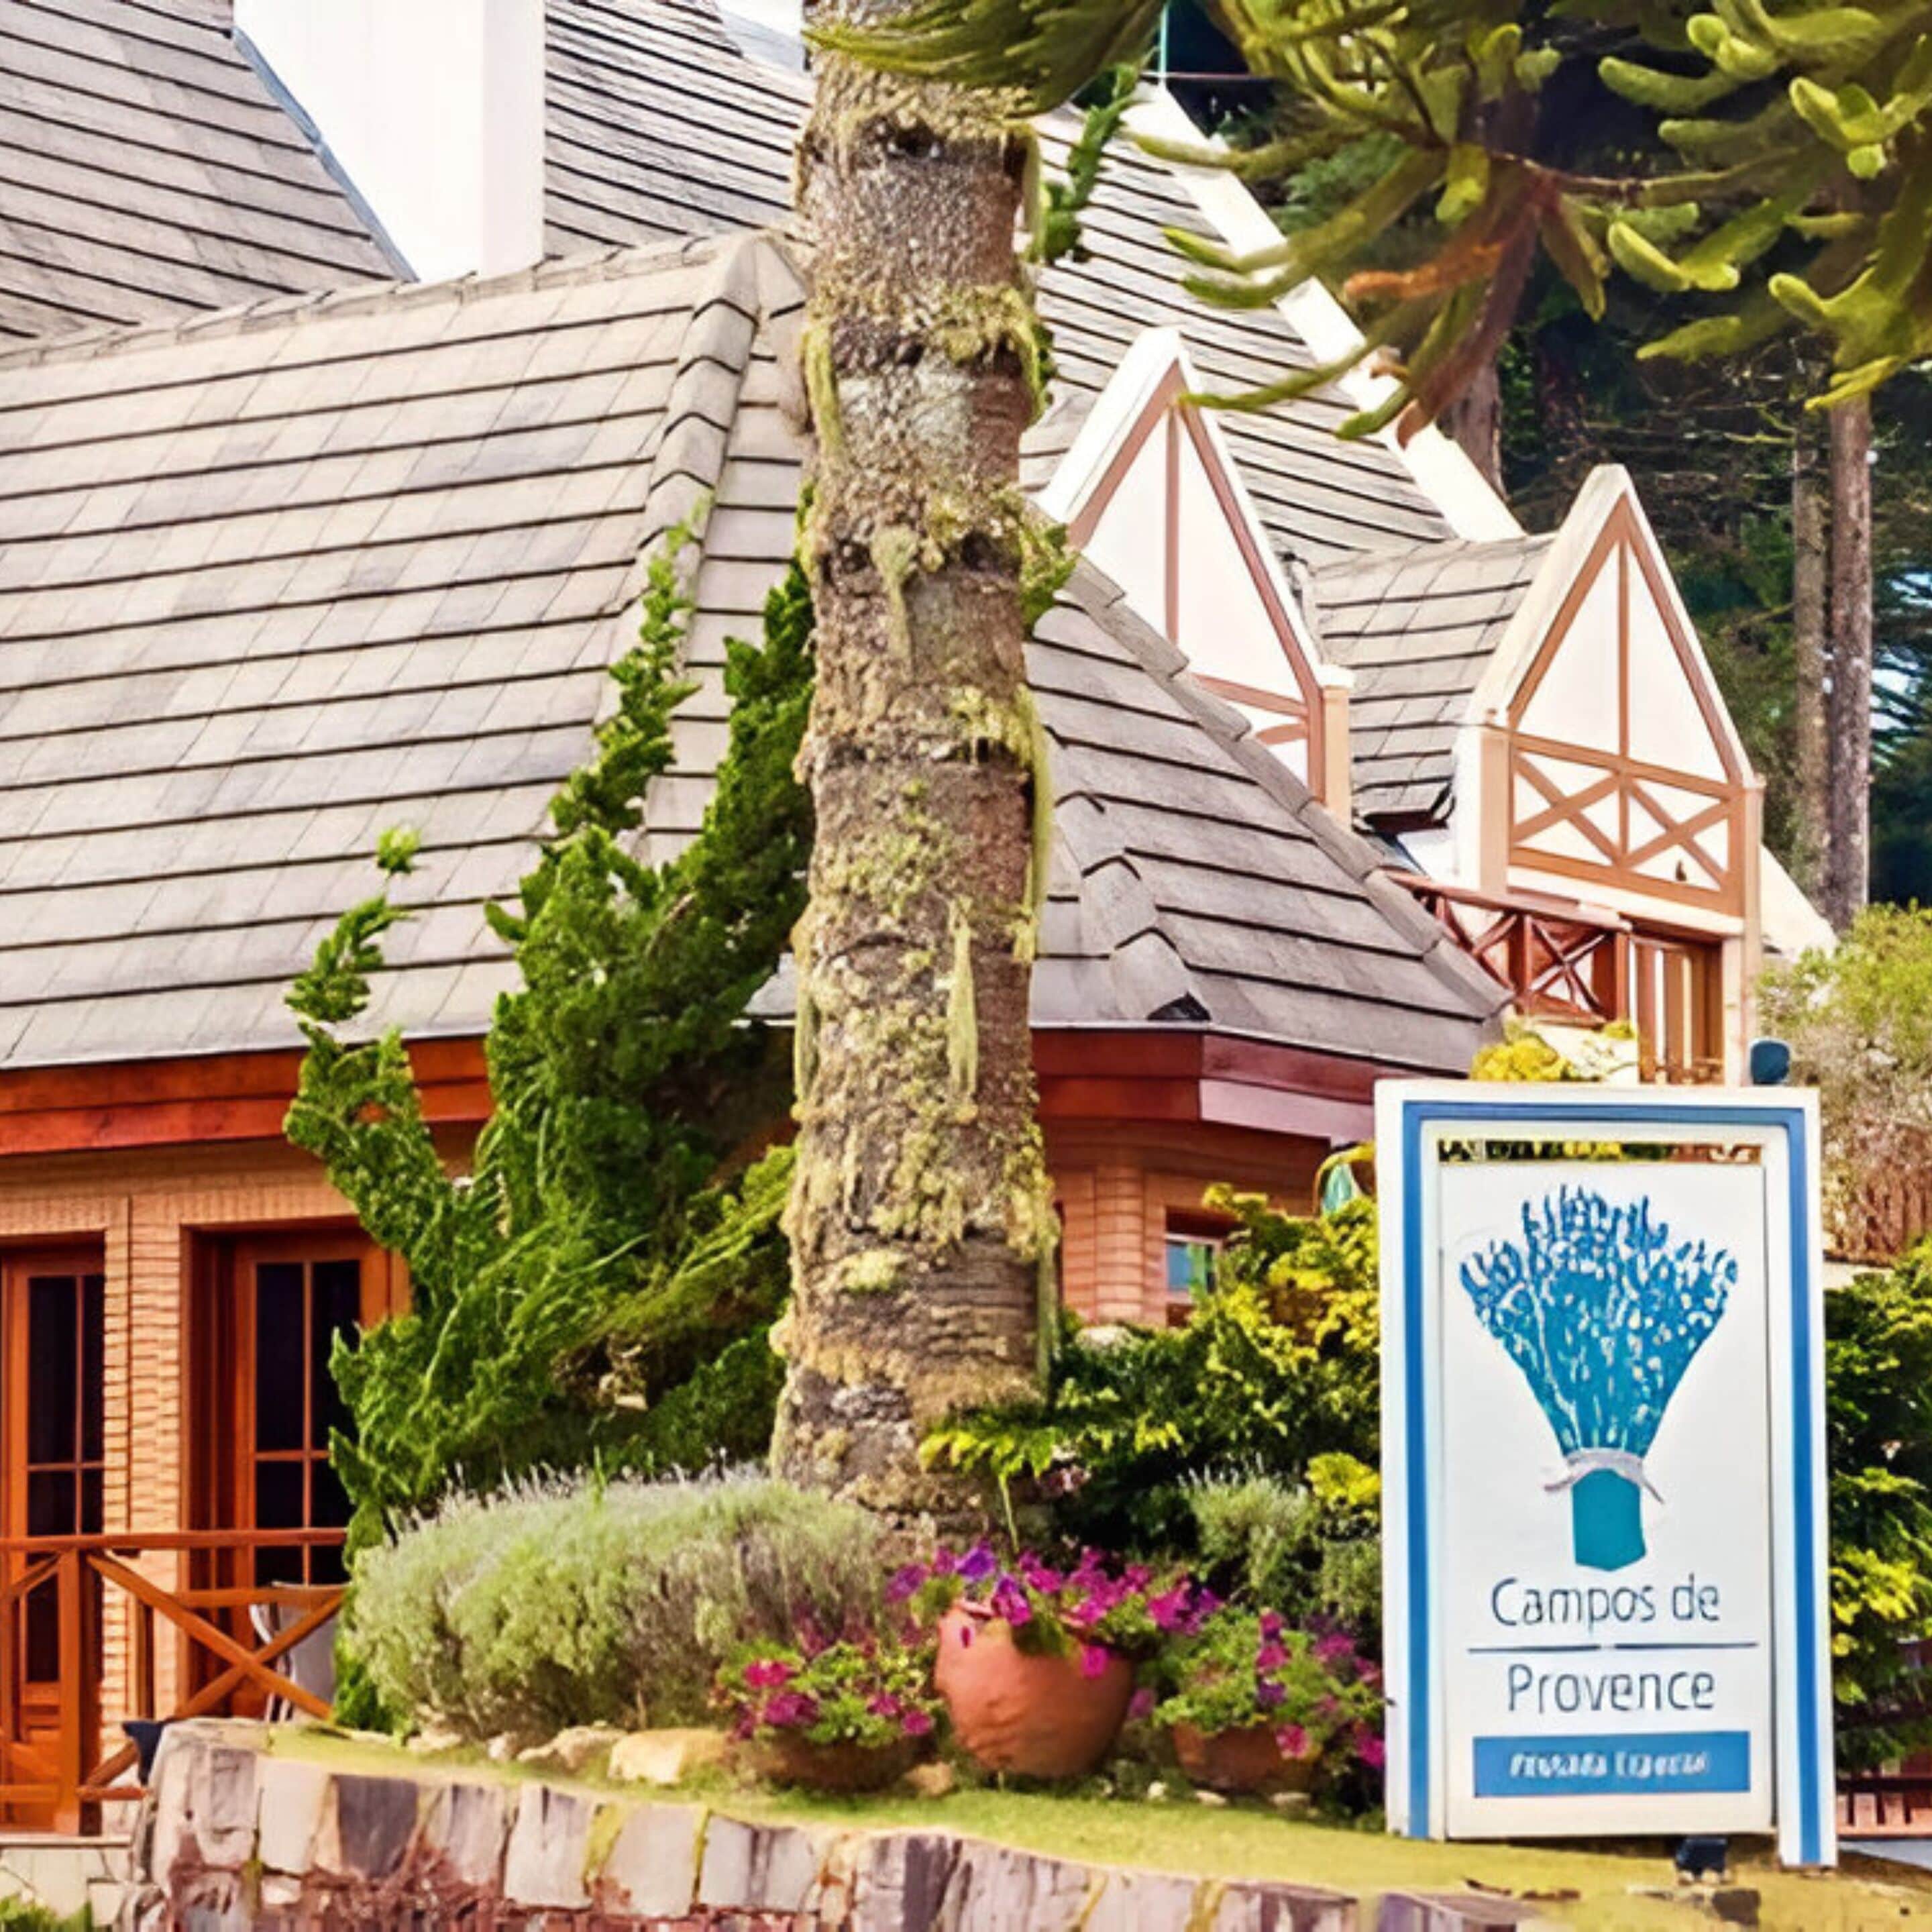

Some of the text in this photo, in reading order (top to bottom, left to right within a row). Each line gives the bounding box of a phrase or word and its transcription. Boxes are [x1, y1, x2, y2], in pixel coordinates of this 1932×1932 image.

[1491, 1572, 1721, 1633] Campos de
[1507, 1663, 1715, 1715] Provence
